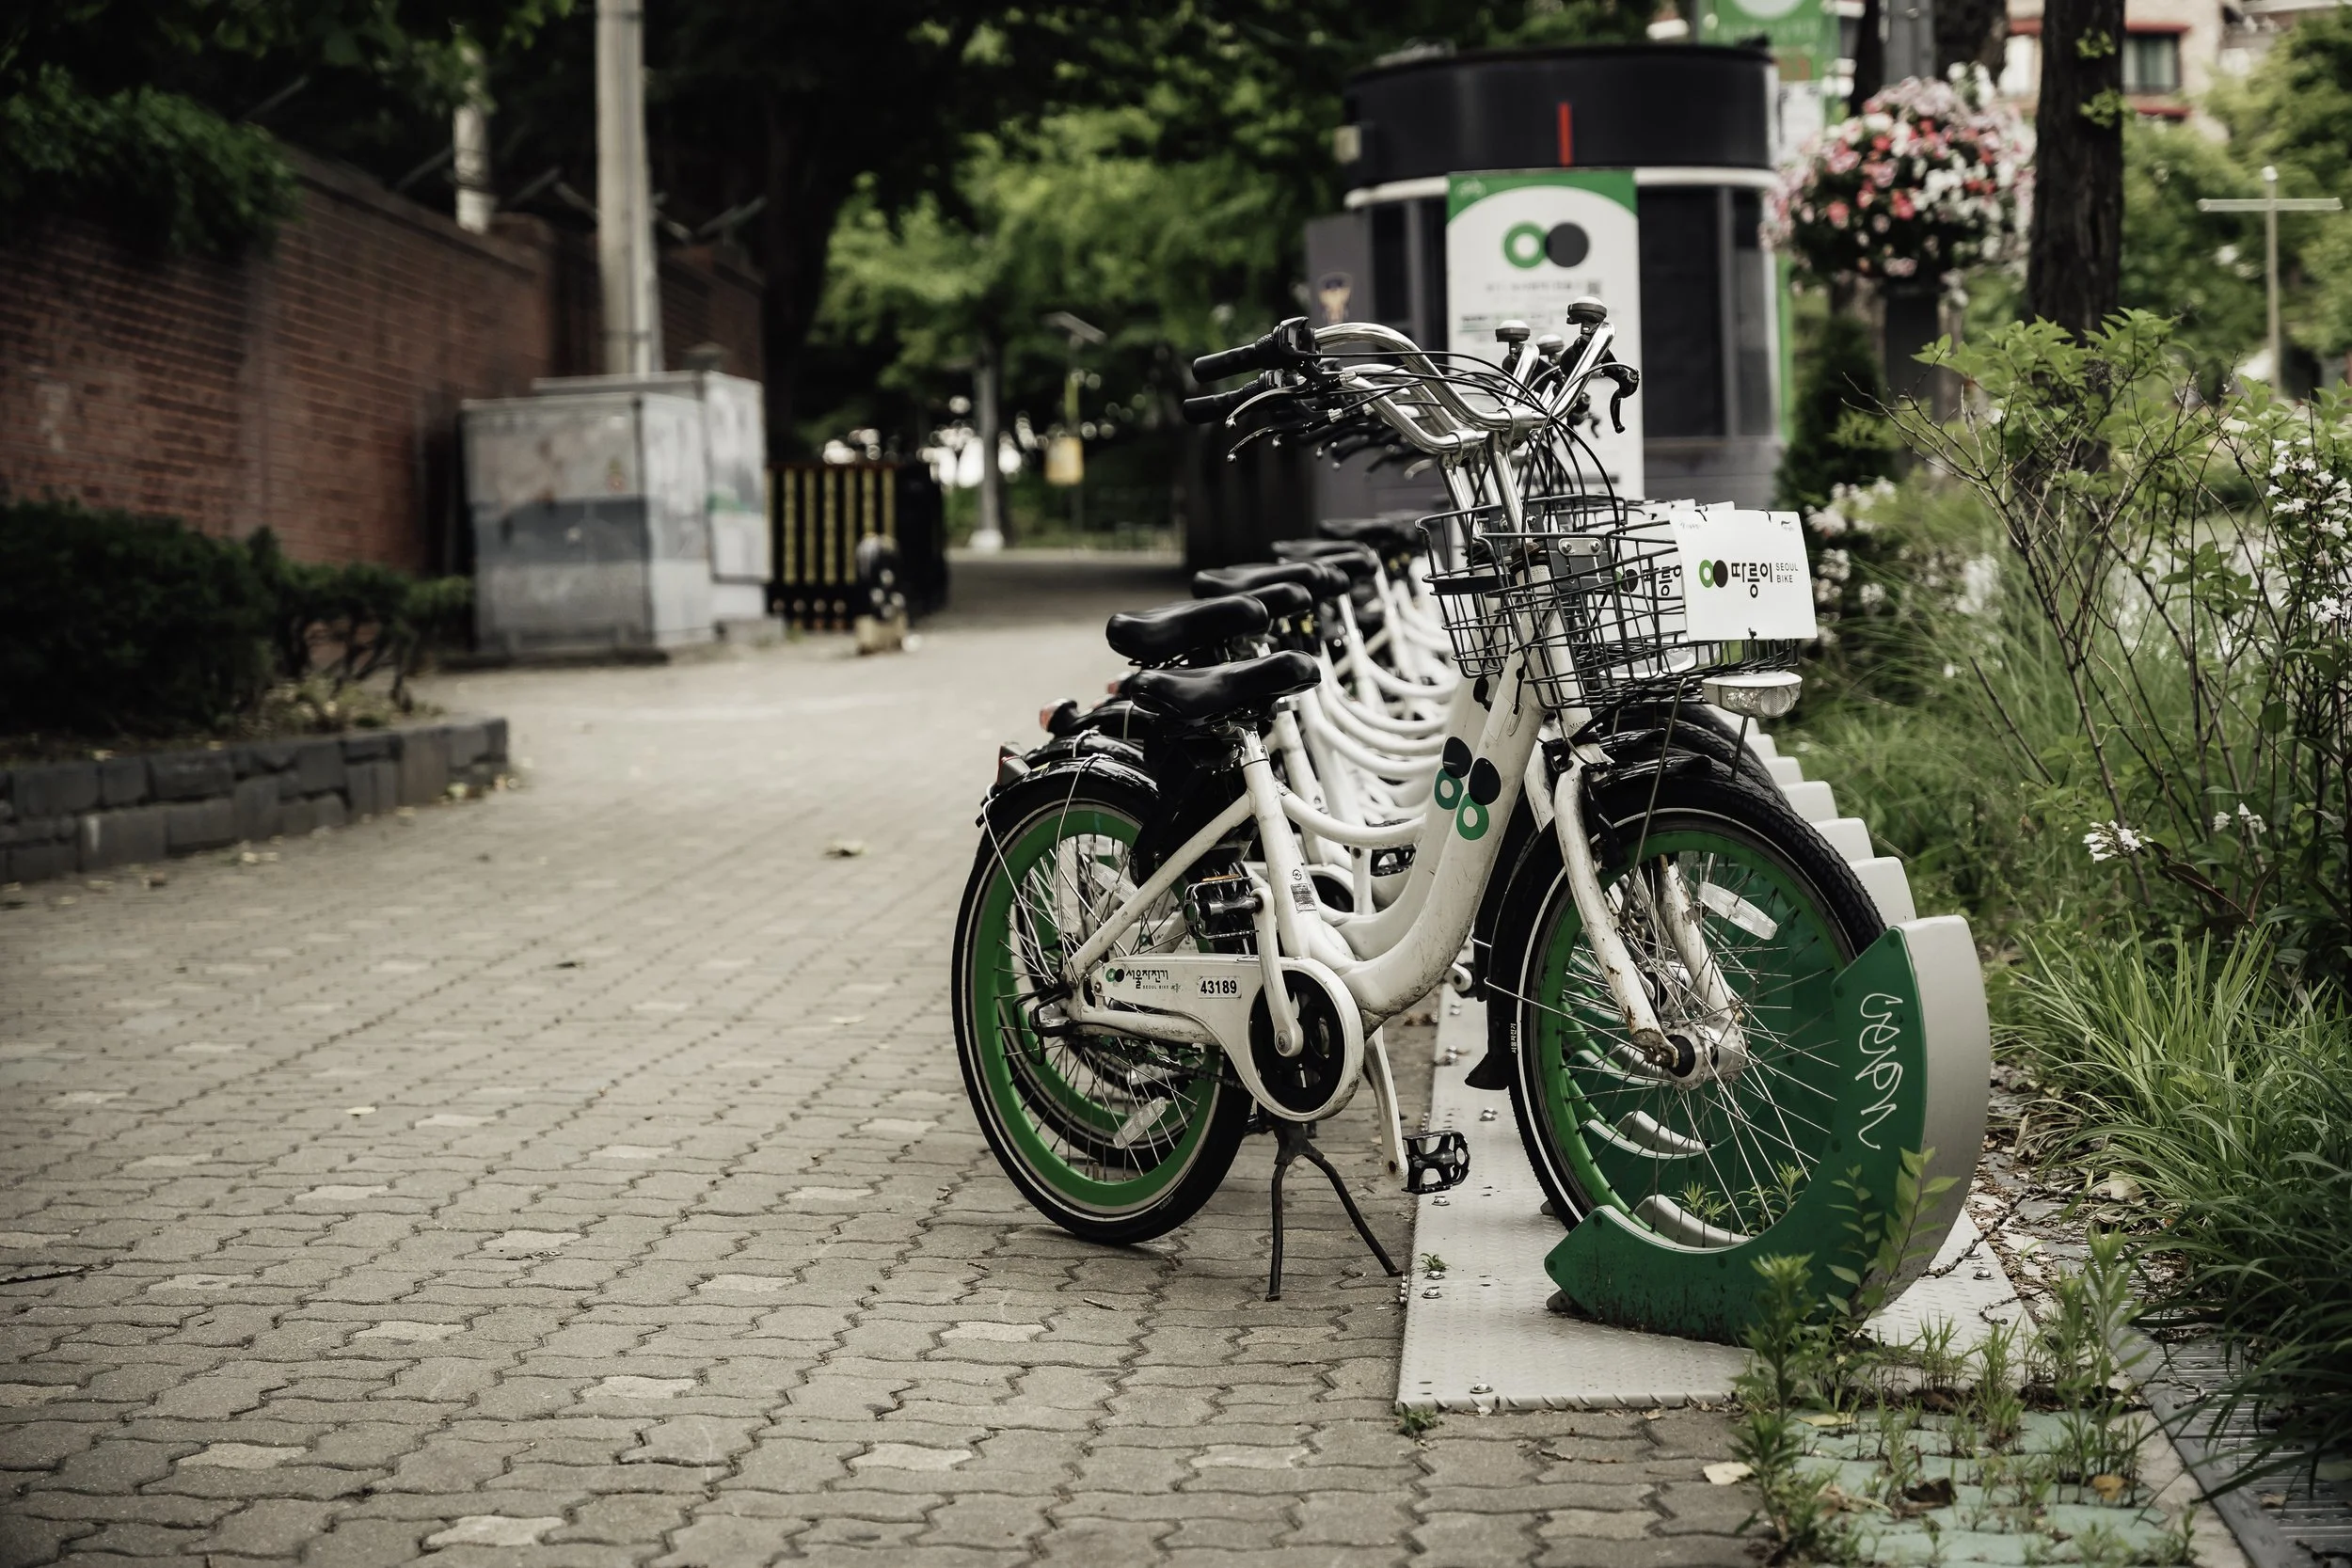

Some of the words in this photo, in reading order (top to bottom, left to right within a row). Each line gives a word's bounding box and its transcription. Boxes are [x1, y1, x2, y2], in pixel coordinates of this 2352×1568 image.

[1775, 562, 1799, 572] SEOUL
[1731, 562, 1773, 599] 따릉이
[1776, 575, 1793, 583] BIKE
[1125, 969, 1168, 990] 서울자전거
[1200, 980, 1237, 994] 43189
